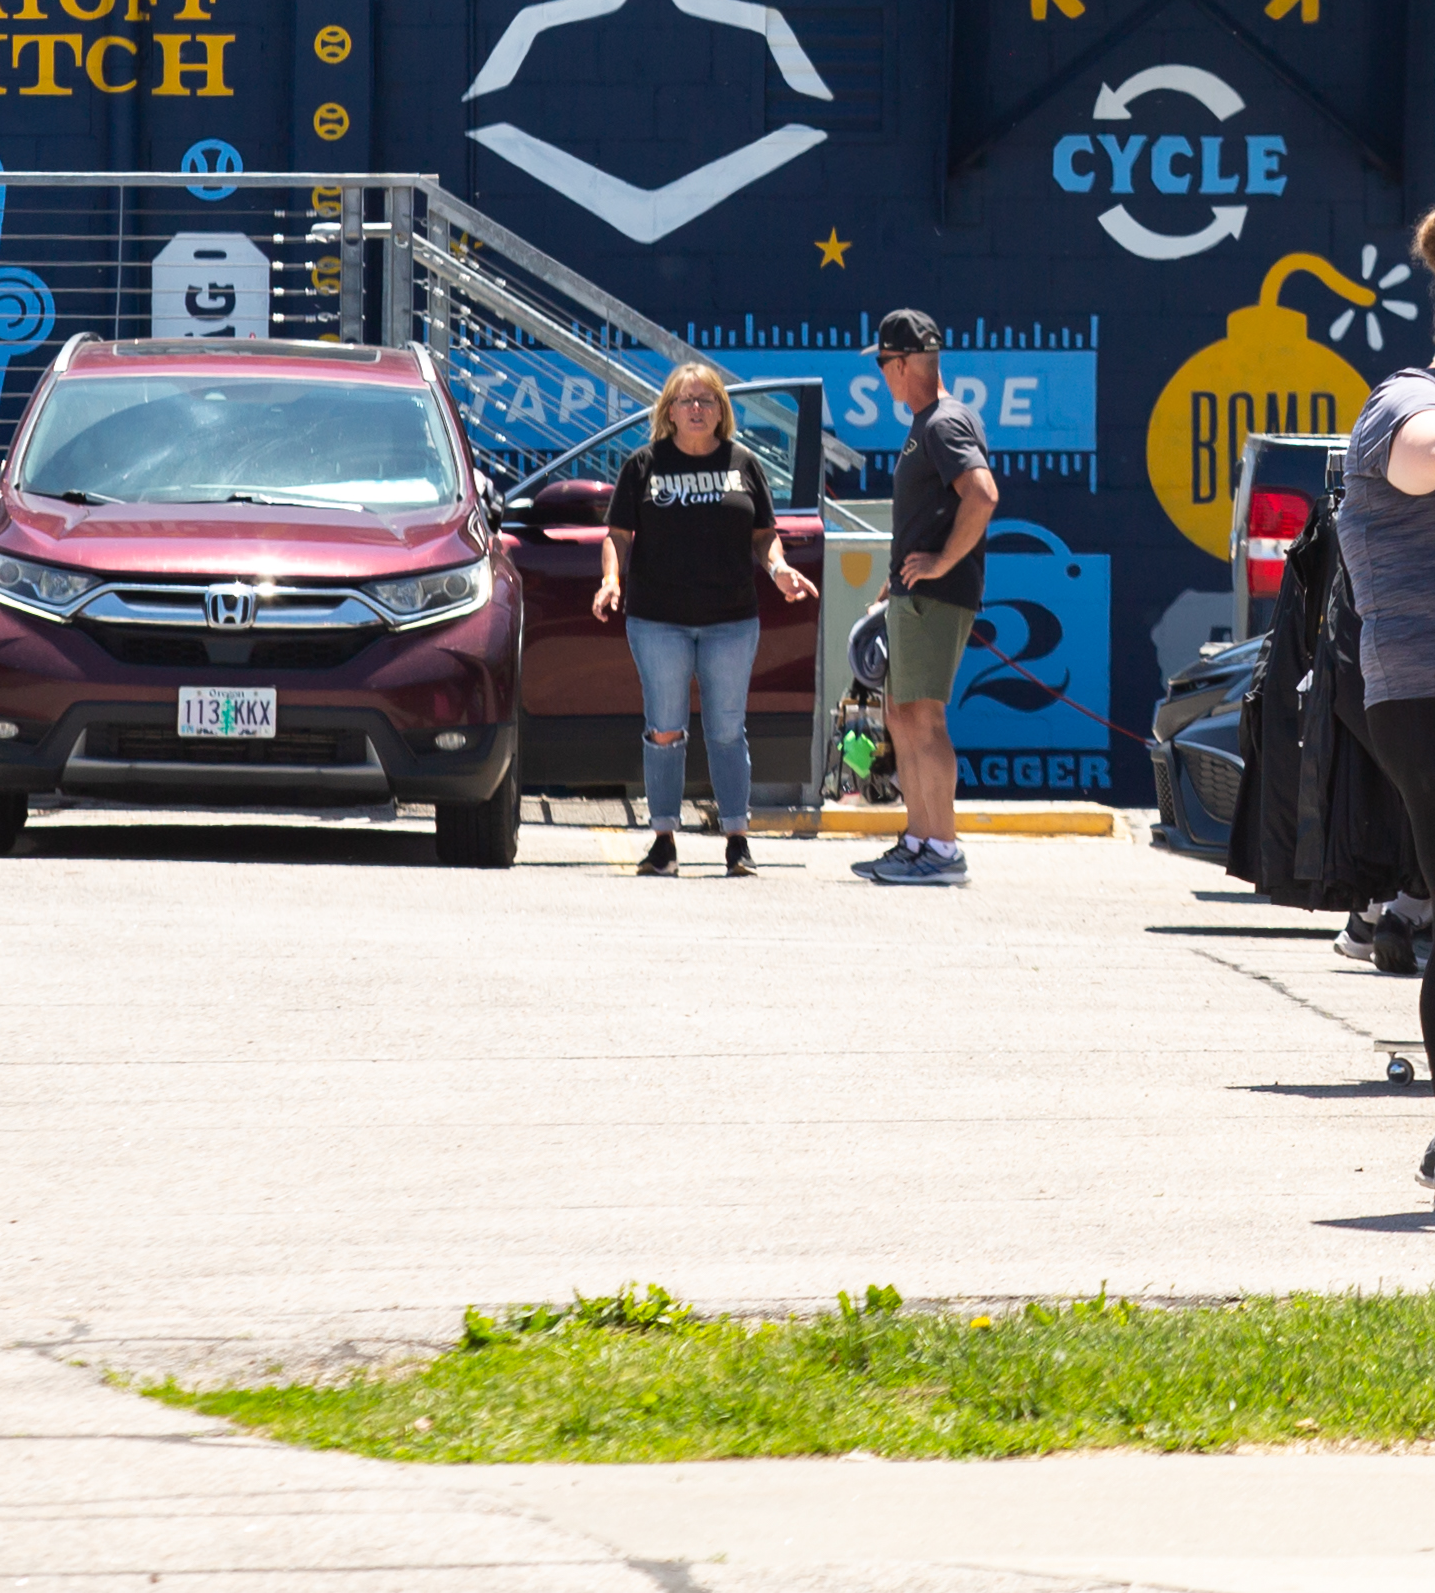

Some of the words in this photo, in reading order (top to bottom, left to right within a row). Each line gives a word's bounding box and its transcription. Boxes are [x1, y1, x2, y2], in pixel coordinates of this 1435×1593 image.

[1052, 134, 1287, 196] CYCLE
[650, 470, 743, 496] PURDUE
[209, 689, 245, 699] Oregon
[185, 699, 220, 725] 113
[234, 699, 271, 726] KKX
